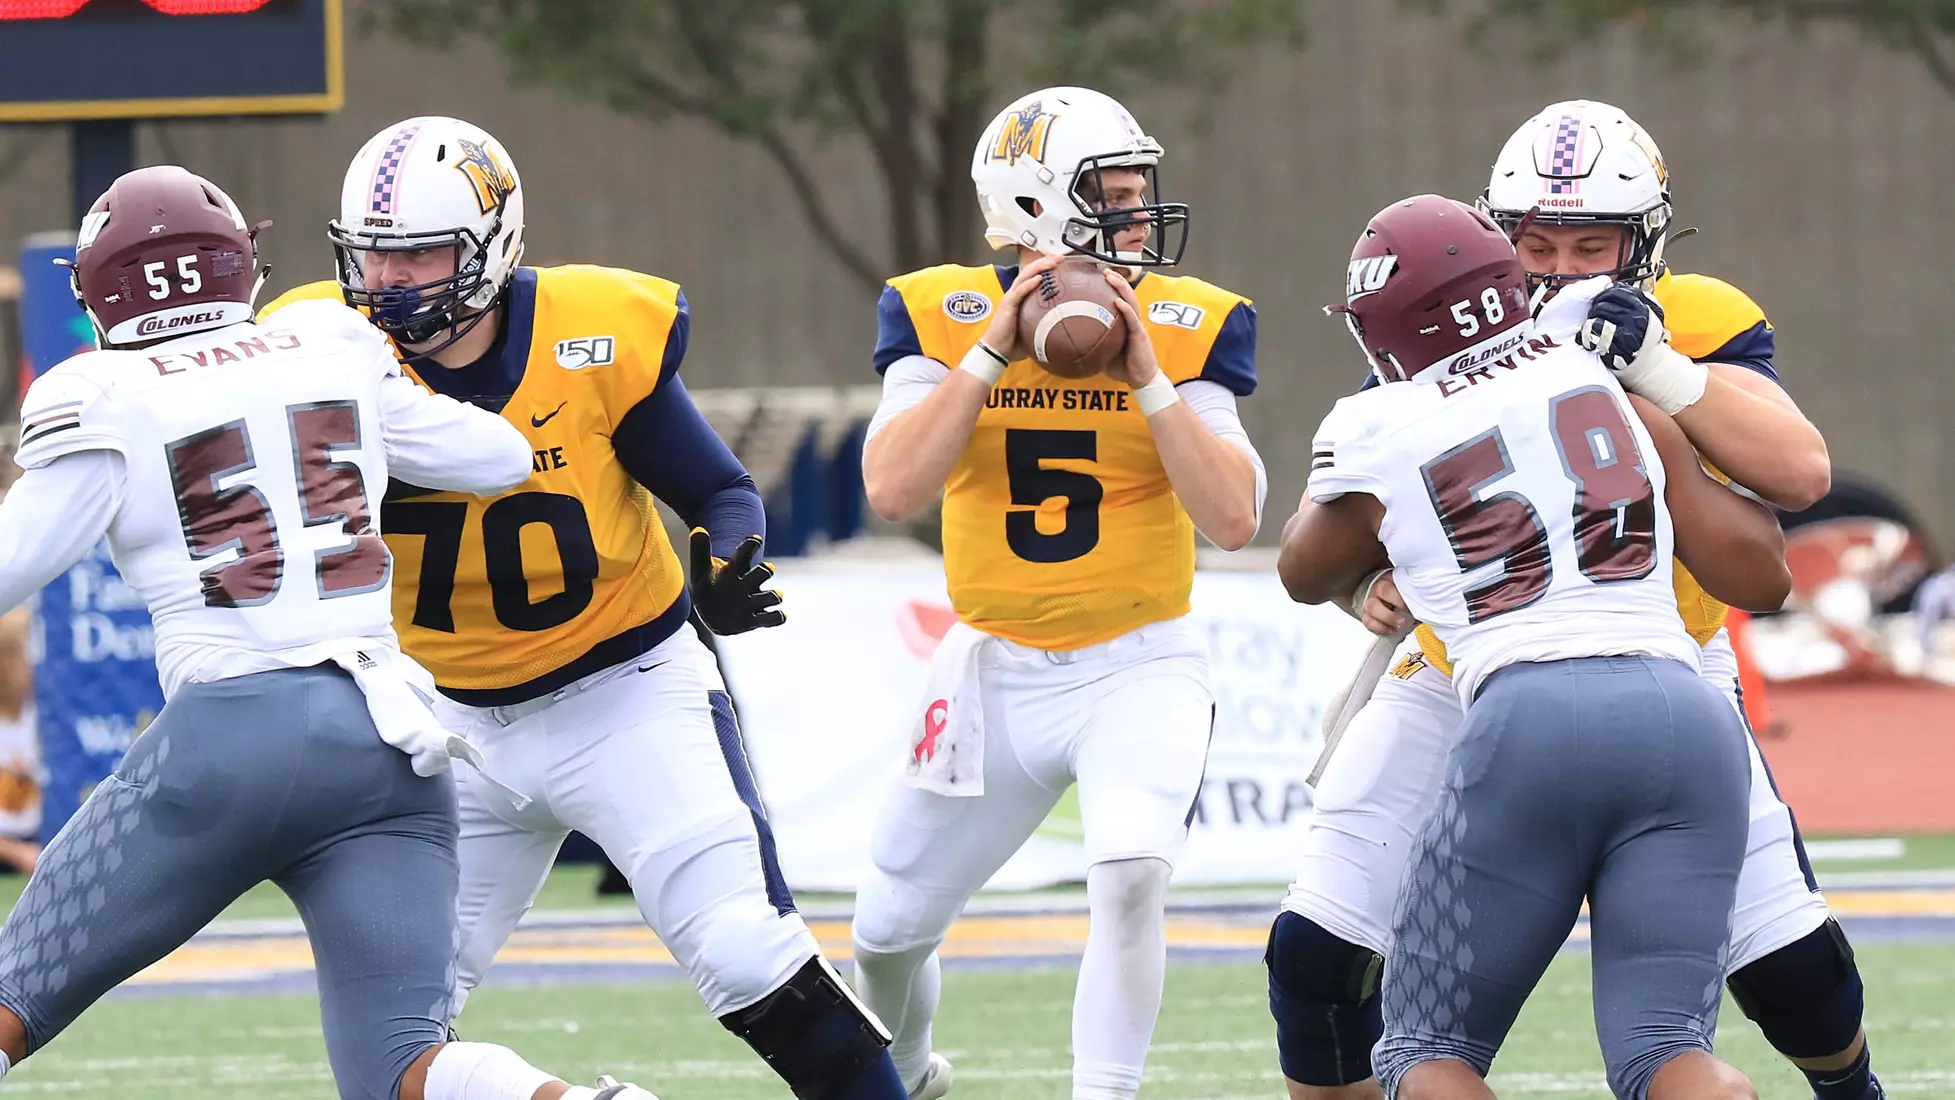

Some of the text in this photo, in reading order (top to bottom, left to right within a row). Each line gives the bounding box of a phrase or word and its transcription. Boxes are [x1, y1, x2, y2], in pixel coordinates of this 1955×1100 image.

[363, 217, 394, 228] SPEED
[1537, 198, 1583, 207] Riddell
[143, 255, 203, 301] 55
[1347, 254, 1399, 298] KU
[136, 310, 224, 336] COLONELS
[1450, 287, 1504, 338] 58
[148, 328, 302, 377] EVANS
[1448, 331, 1525, 376] COLONELS
[986, 387, 1129, 412] URRAY STATE
[164, 398, 391, 609] 55
[1005, 428, 1104, 564] 5
[1419, 384, 1658, 626] 58
[380, 491, 600, 635] 70
[1197, 776, 1315, 827] TRA
